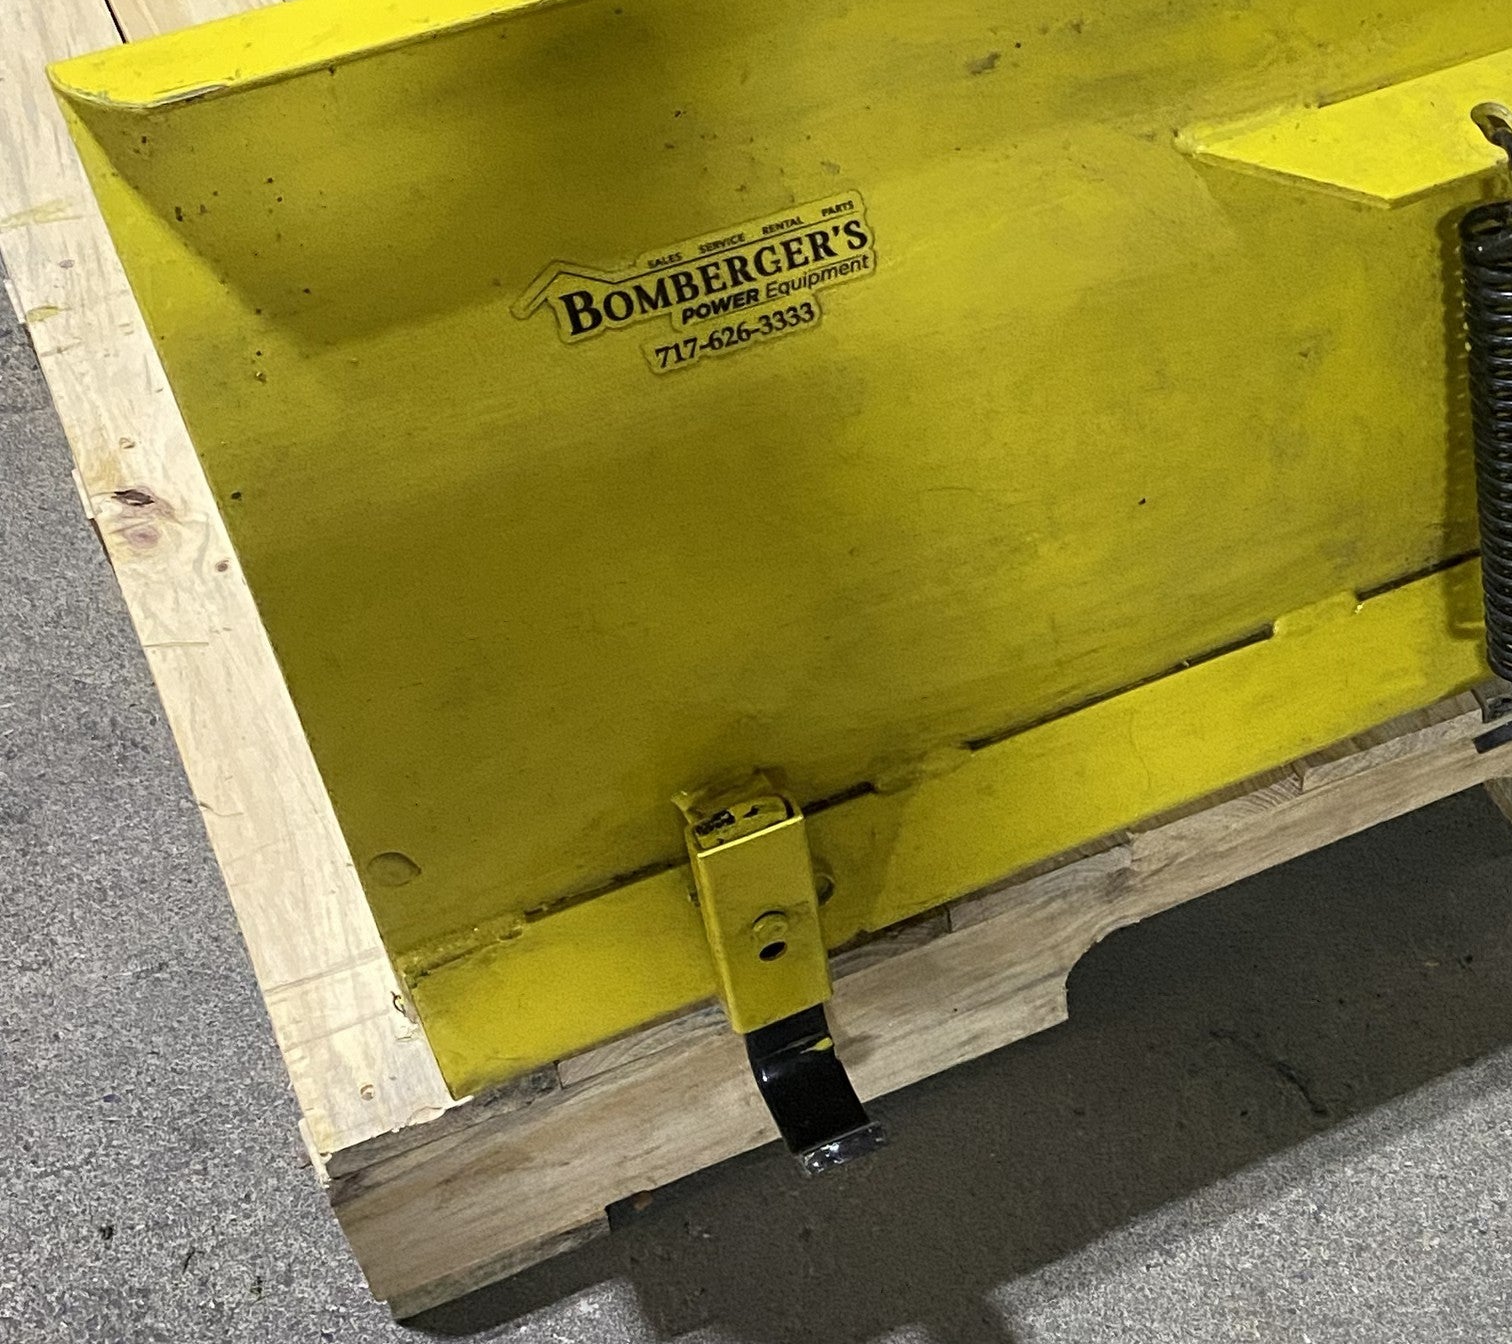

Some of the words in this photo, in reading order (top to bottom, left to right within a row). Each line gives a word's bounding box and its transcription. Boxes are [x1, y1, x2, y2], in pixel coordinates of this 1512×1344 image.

[647, 251, 682, 268] SALES
[698, 233, 745, 254] SERVICE
[762, 216, 804, 235] RENTAL
[821, 200, 855, 218] PARTS
[560, 219, 868, 336] BOMBERGER'S
[682, 288, 760, 324] POWER
[765, 255, 870, 298] Equipment
[655, 302, 815, 368] 717-626-3333
